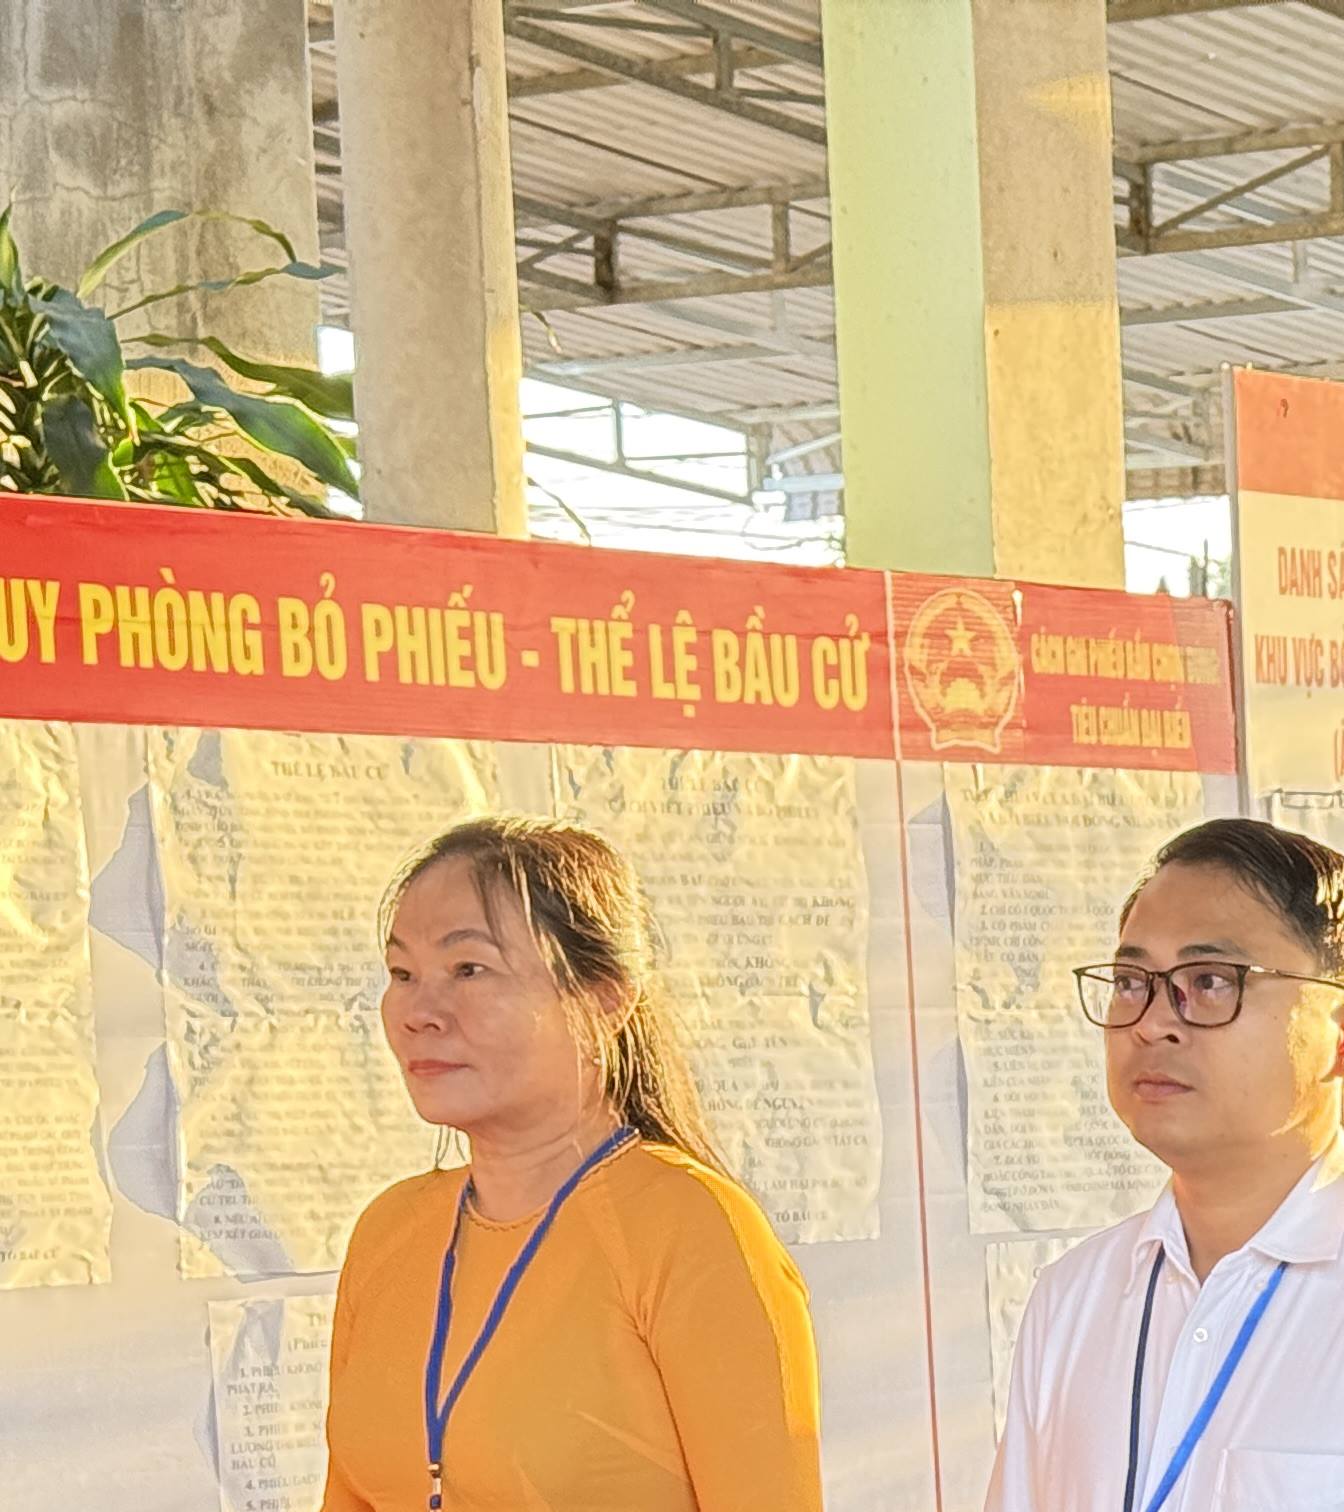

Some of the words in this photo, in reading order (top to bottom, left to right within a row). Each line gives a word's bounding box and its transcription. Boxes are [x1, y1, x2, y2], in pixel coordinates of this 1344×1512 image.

[1277, 545, 1323, 597] DANH
[79, 567, 264, 677] PHÒNG
[278, 572, 347, 681] BỎ
[362, 584, 508, 690] PHIẾU
[522, 652, 540, 667] -
[551, 590, 638, 698] THỂ
[648, 610, 702, 718] LỆ
[711, 606, 798, 708] BẦU
[811, 613, 871, 712] CỬ
[1031, 626, 1064, 675] CÁCH
[1255, 634, 1288, 686] KHU
[1291, 637, 1325, 699] VỰC
